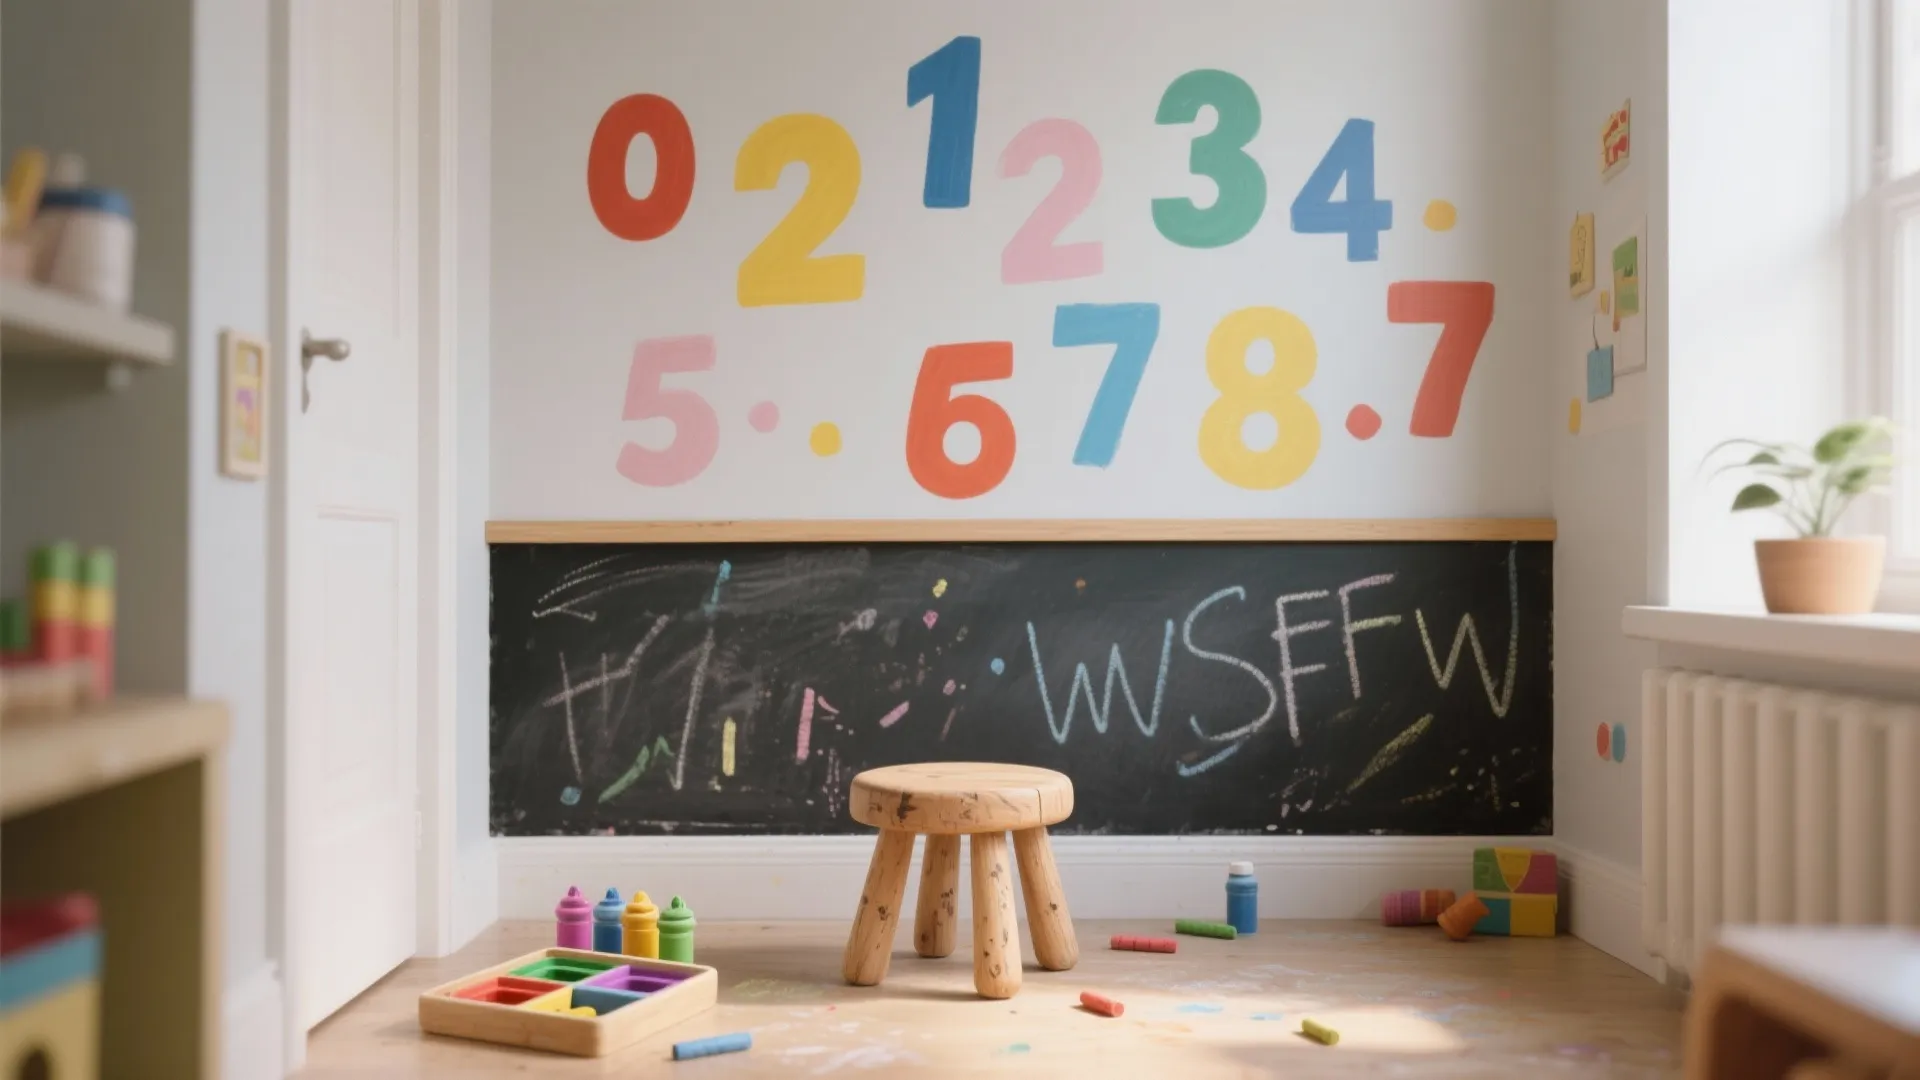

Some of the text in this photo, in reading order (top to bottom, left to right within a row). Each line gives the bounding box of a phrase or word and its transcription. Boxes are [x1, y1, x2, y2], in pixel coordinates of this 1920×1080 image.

[587, 36, 1392, 307] 0 2 1 2 3 4
[616, 281, 1495, 499] 5 6 7 8 7
